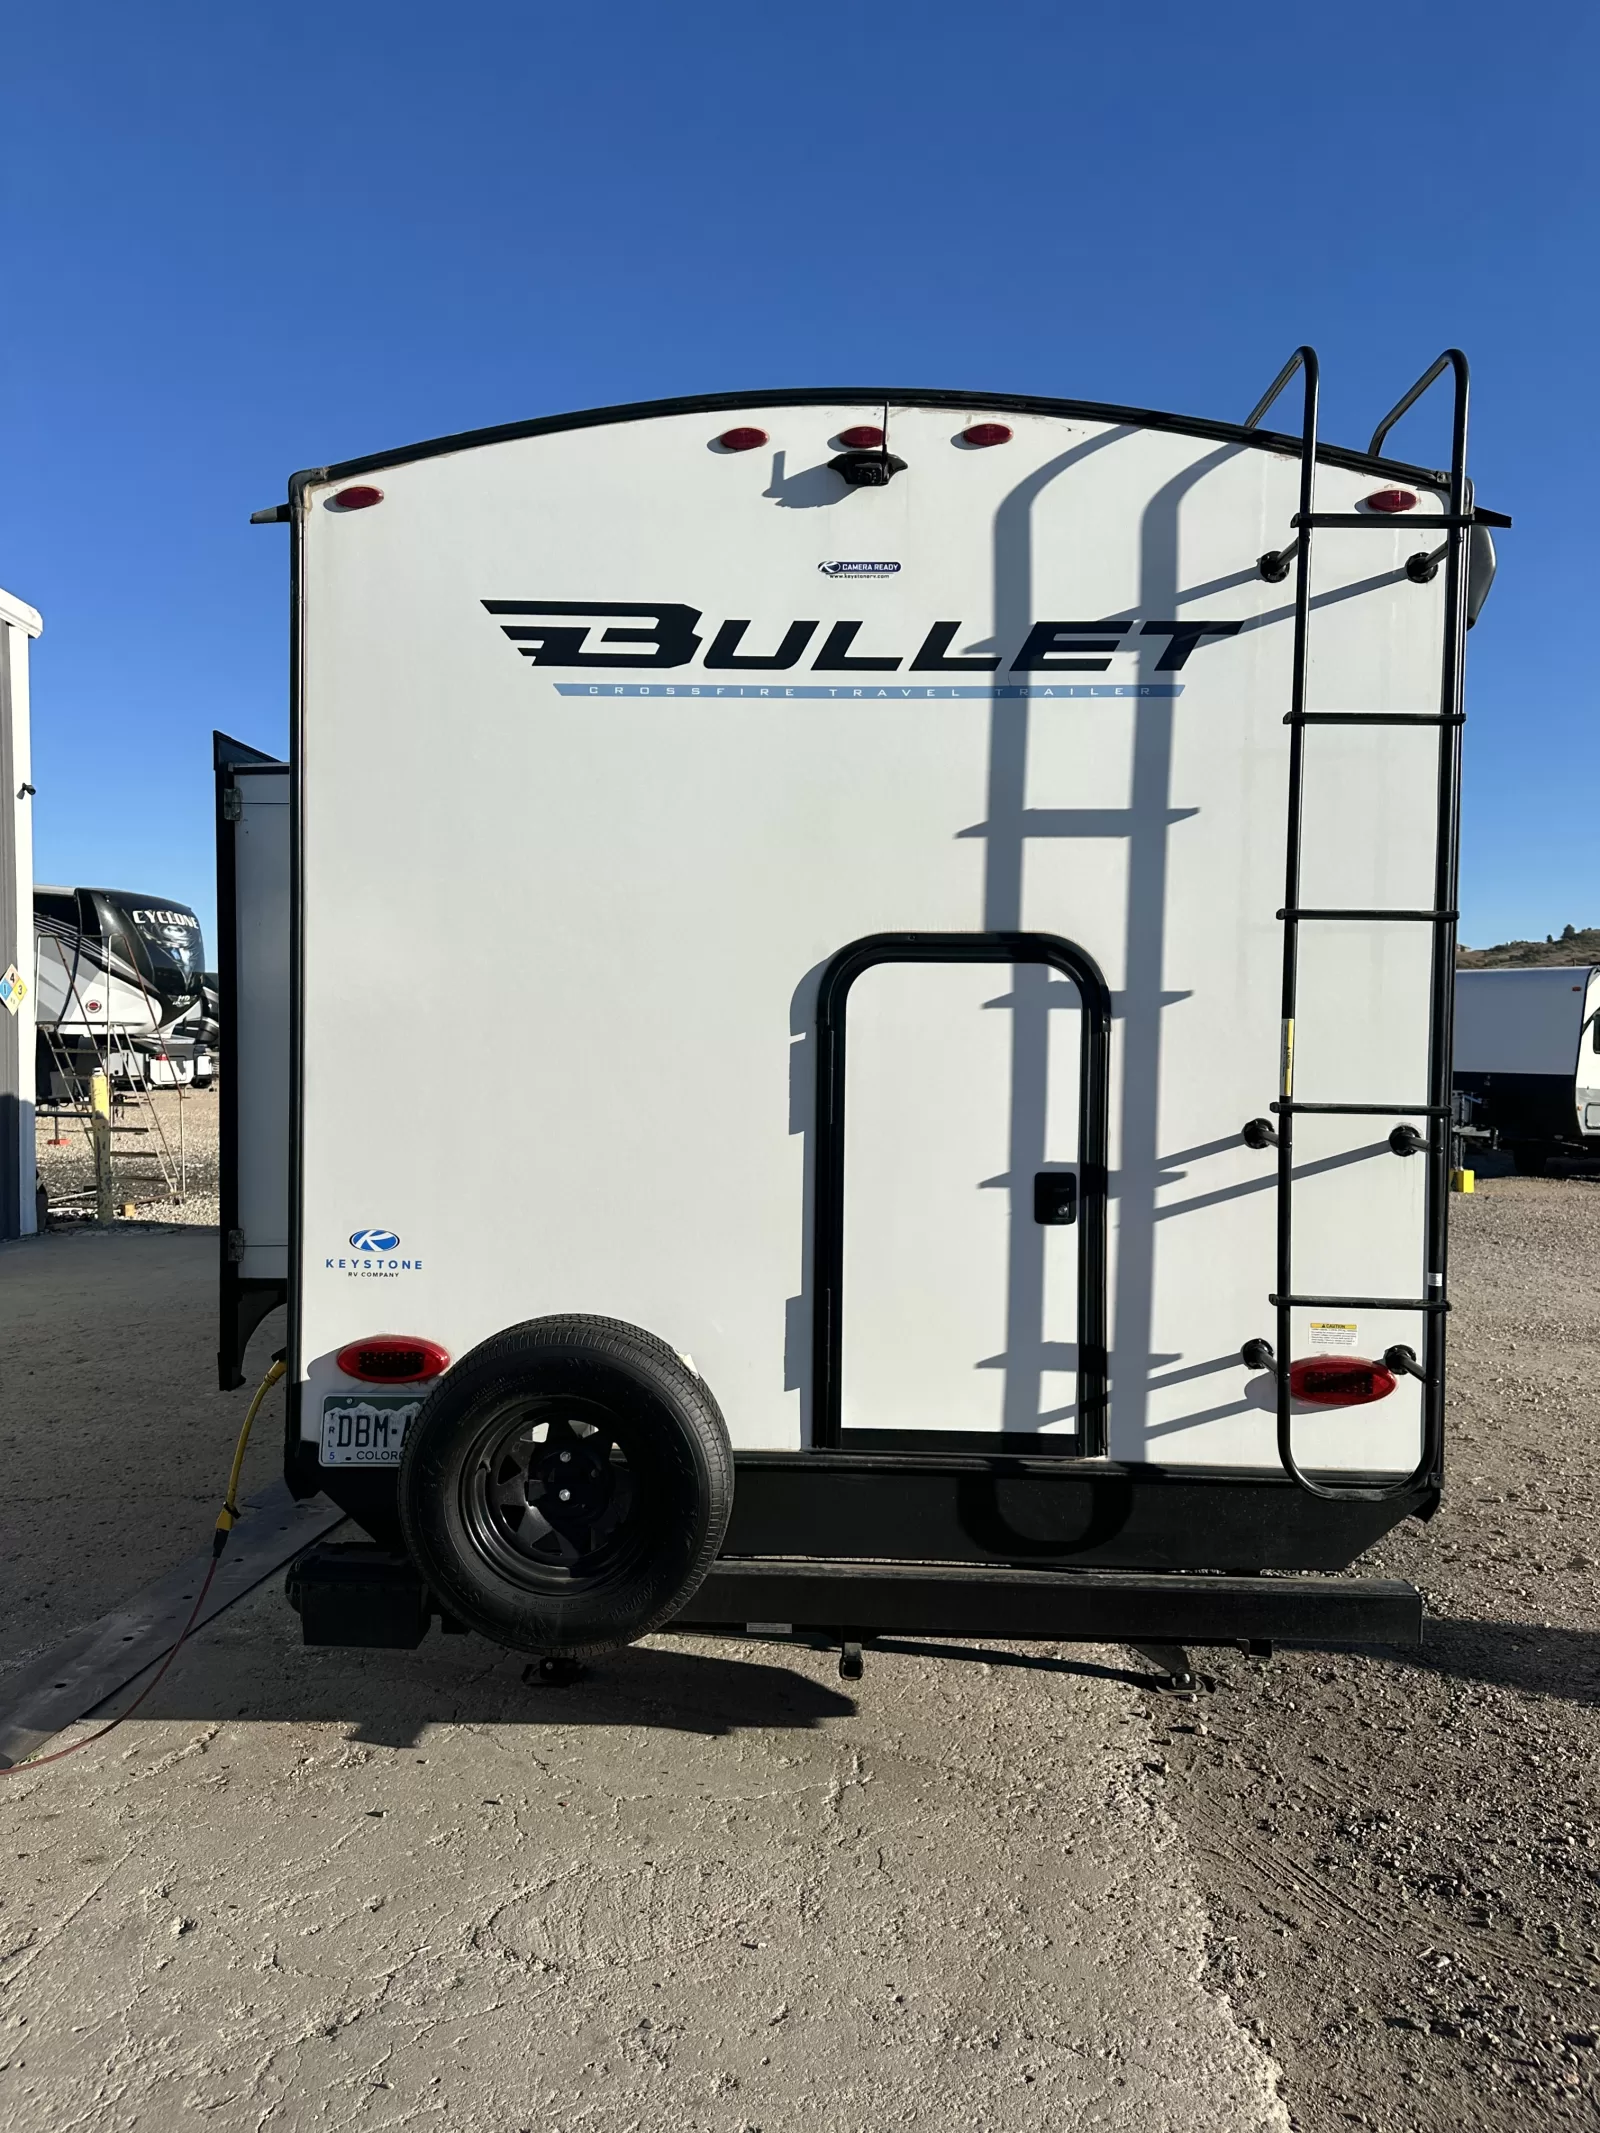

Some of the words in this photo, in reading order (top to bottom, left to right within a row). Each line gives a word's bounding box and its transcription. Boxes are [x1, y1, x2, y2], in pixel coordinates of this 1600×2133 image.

[842, 563, 872, 571] CAMERA
[480, 599, 1245, 671] BULLET
[589, 686, 794, 696] CROSSFIRE
[829, 688, 960, 697] TRAVEL
[995, 687, 1150, 697] TRAILER
[132, 910, 199, 929] CYCLONE
[10, 973, 15, 983] 4
[18, 985, 22, 995] 3
[325, 1259, 422, 1270] KEYSTONE
[329, 1451, 335, 1460] 5
[356, 1450, 404, 1460] COLOR
